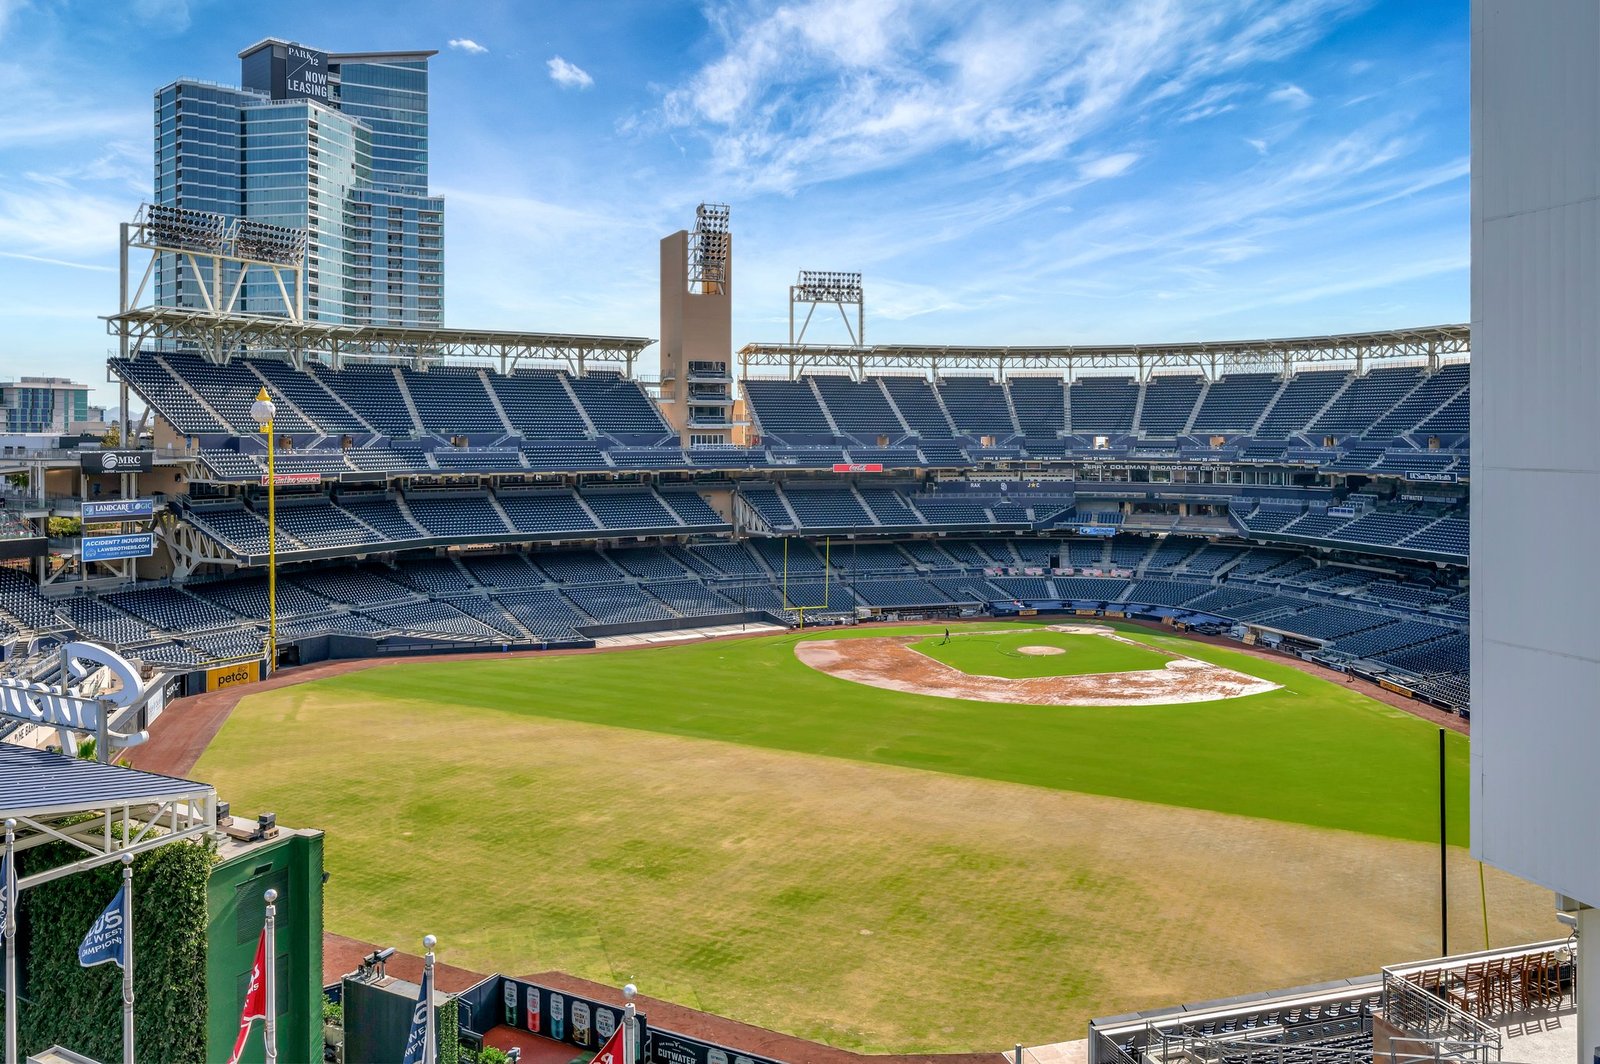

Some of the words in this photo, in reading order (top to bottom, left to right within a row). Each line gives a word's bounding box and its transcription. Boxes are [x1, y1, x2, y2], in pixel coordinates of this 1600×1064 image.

[288, 47, 312, 59] PARK
[310, 57, 319, 66] 12
[305, 70, 327, 85] NOW
[288, 79, 327, 97] LEASING
[117, 455, 141, 464] MRC
[95, 504, 129, 512] LANDCARE
[131, 502, 152, 510] LOGIC
[85, 539, 120, 547] ACCIDENT?
[121, 536, 150, 544] INJURED?
[97, 544, 150, 553] LAWBROTHERS.COM
[218, 671, 249, 687] petco
[657, 1047, 697, 1064] CUTWATER
